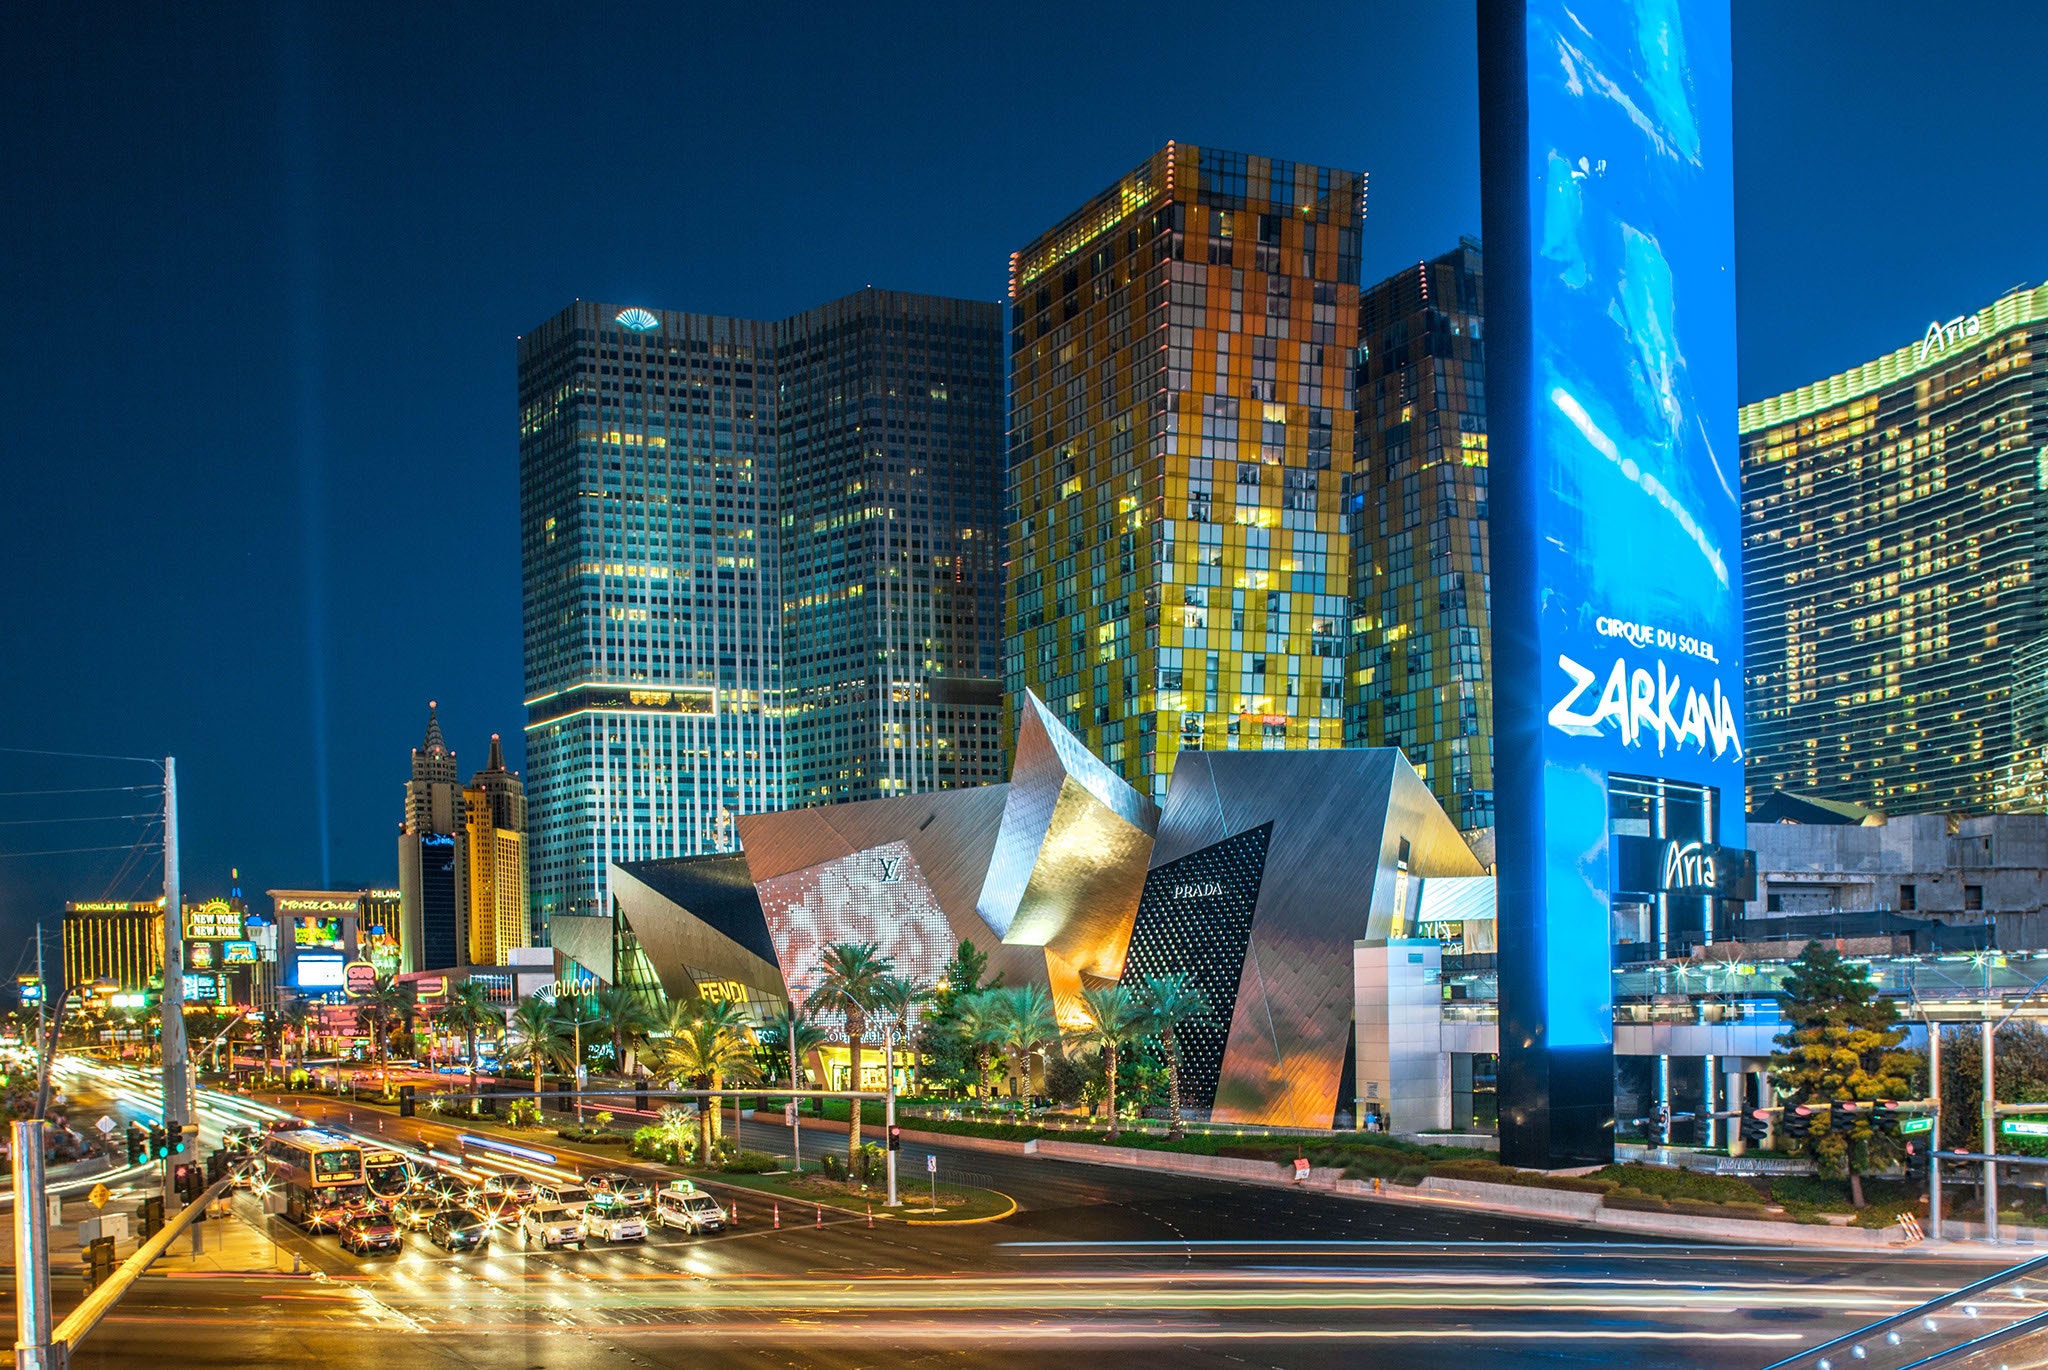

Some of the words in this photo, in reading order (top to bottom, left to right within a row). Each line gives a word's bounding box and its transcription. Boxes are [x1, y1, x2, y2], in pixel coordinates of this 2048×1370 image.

[1920, 315, 1980, 362] Aria
[1595, 616, 1654, 649] CIRQUE
[1657, 626, 1677, 649] DU
[1548, 653, 1743, 760] ZARKANA
[1665, 840, 1717, 890] Aria
[372, 890, 401, 899] DELANO
[1173, 882, 1223, 900] PRADA
[75, 902, 114, 911] MANDALAY
[114, 902, 129, 911] BAY
[279, 899, 319, 911] Monte
[320, 900, 357, 911] Carlo
[193, 914, 214, 924] NEW
[216, 914, 241, 925] YORK
[193, 925, 214, 936] NEW
[216, 925, 241, 936] YORK
[553, 977, 597, 998] GUCCI
[698, 980, 749, 1004] FENDI
